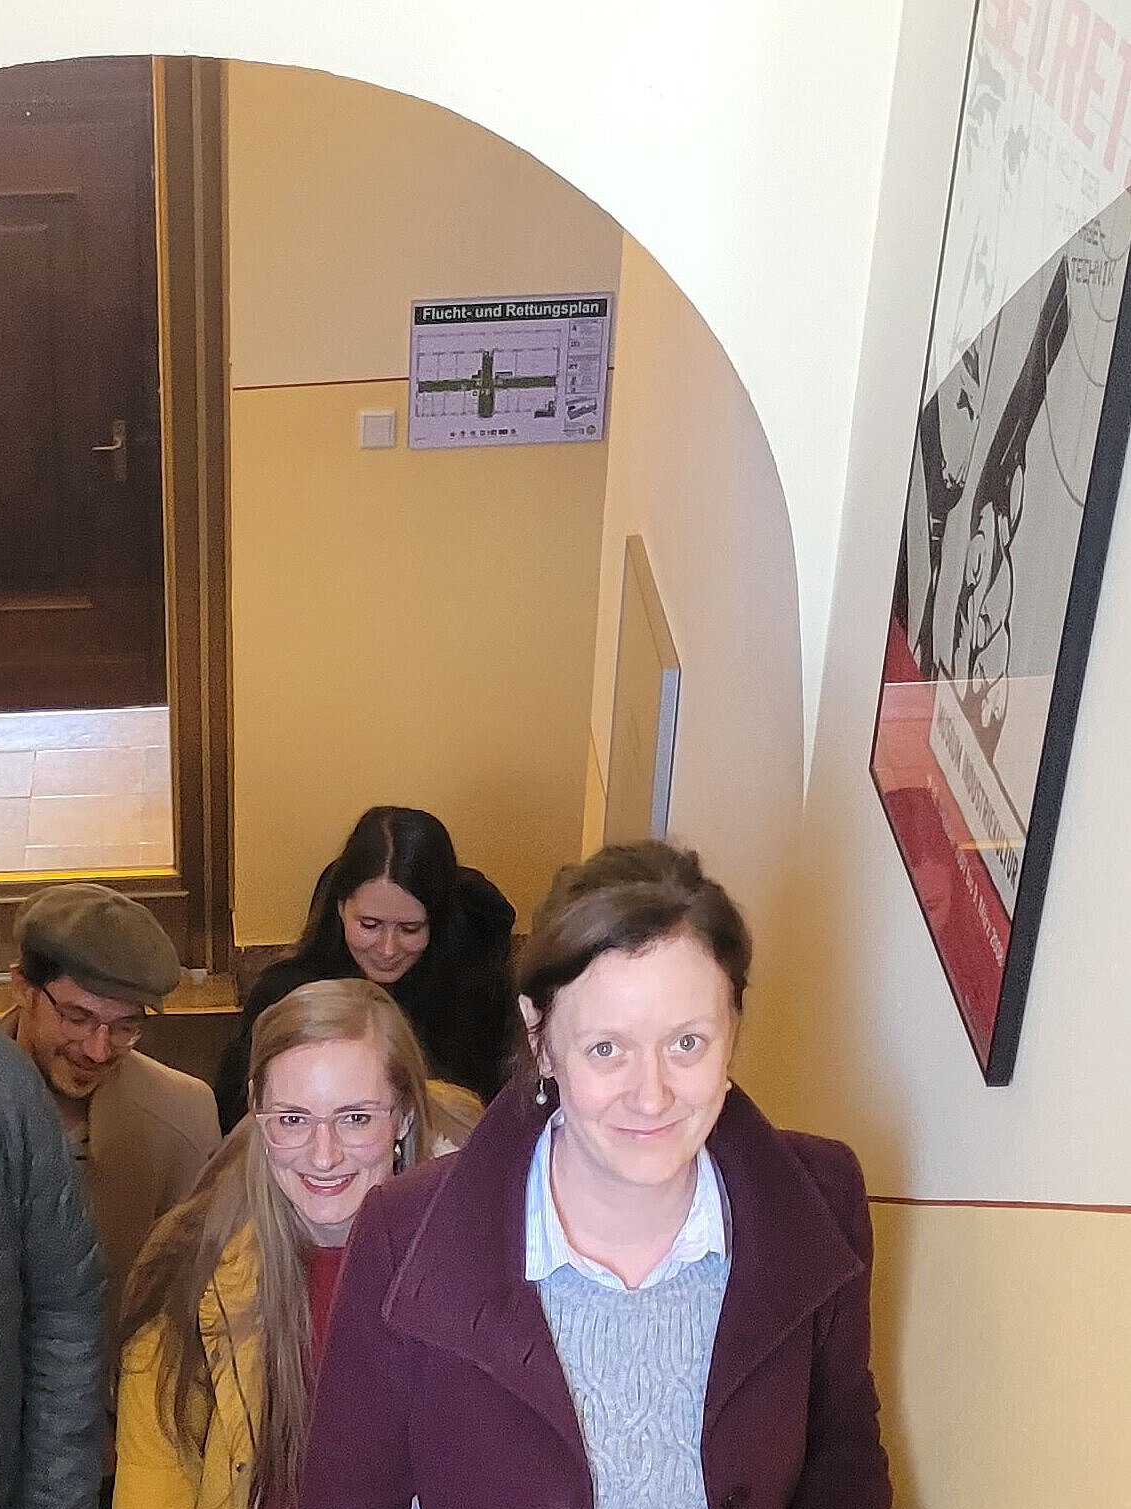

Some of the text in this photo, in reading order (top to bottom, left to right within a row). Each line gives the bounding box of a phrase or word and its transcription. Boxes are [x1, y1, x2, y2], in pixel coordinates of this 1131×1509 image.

[422, 301, 600, 320] Flucht- und Rettungsplan
